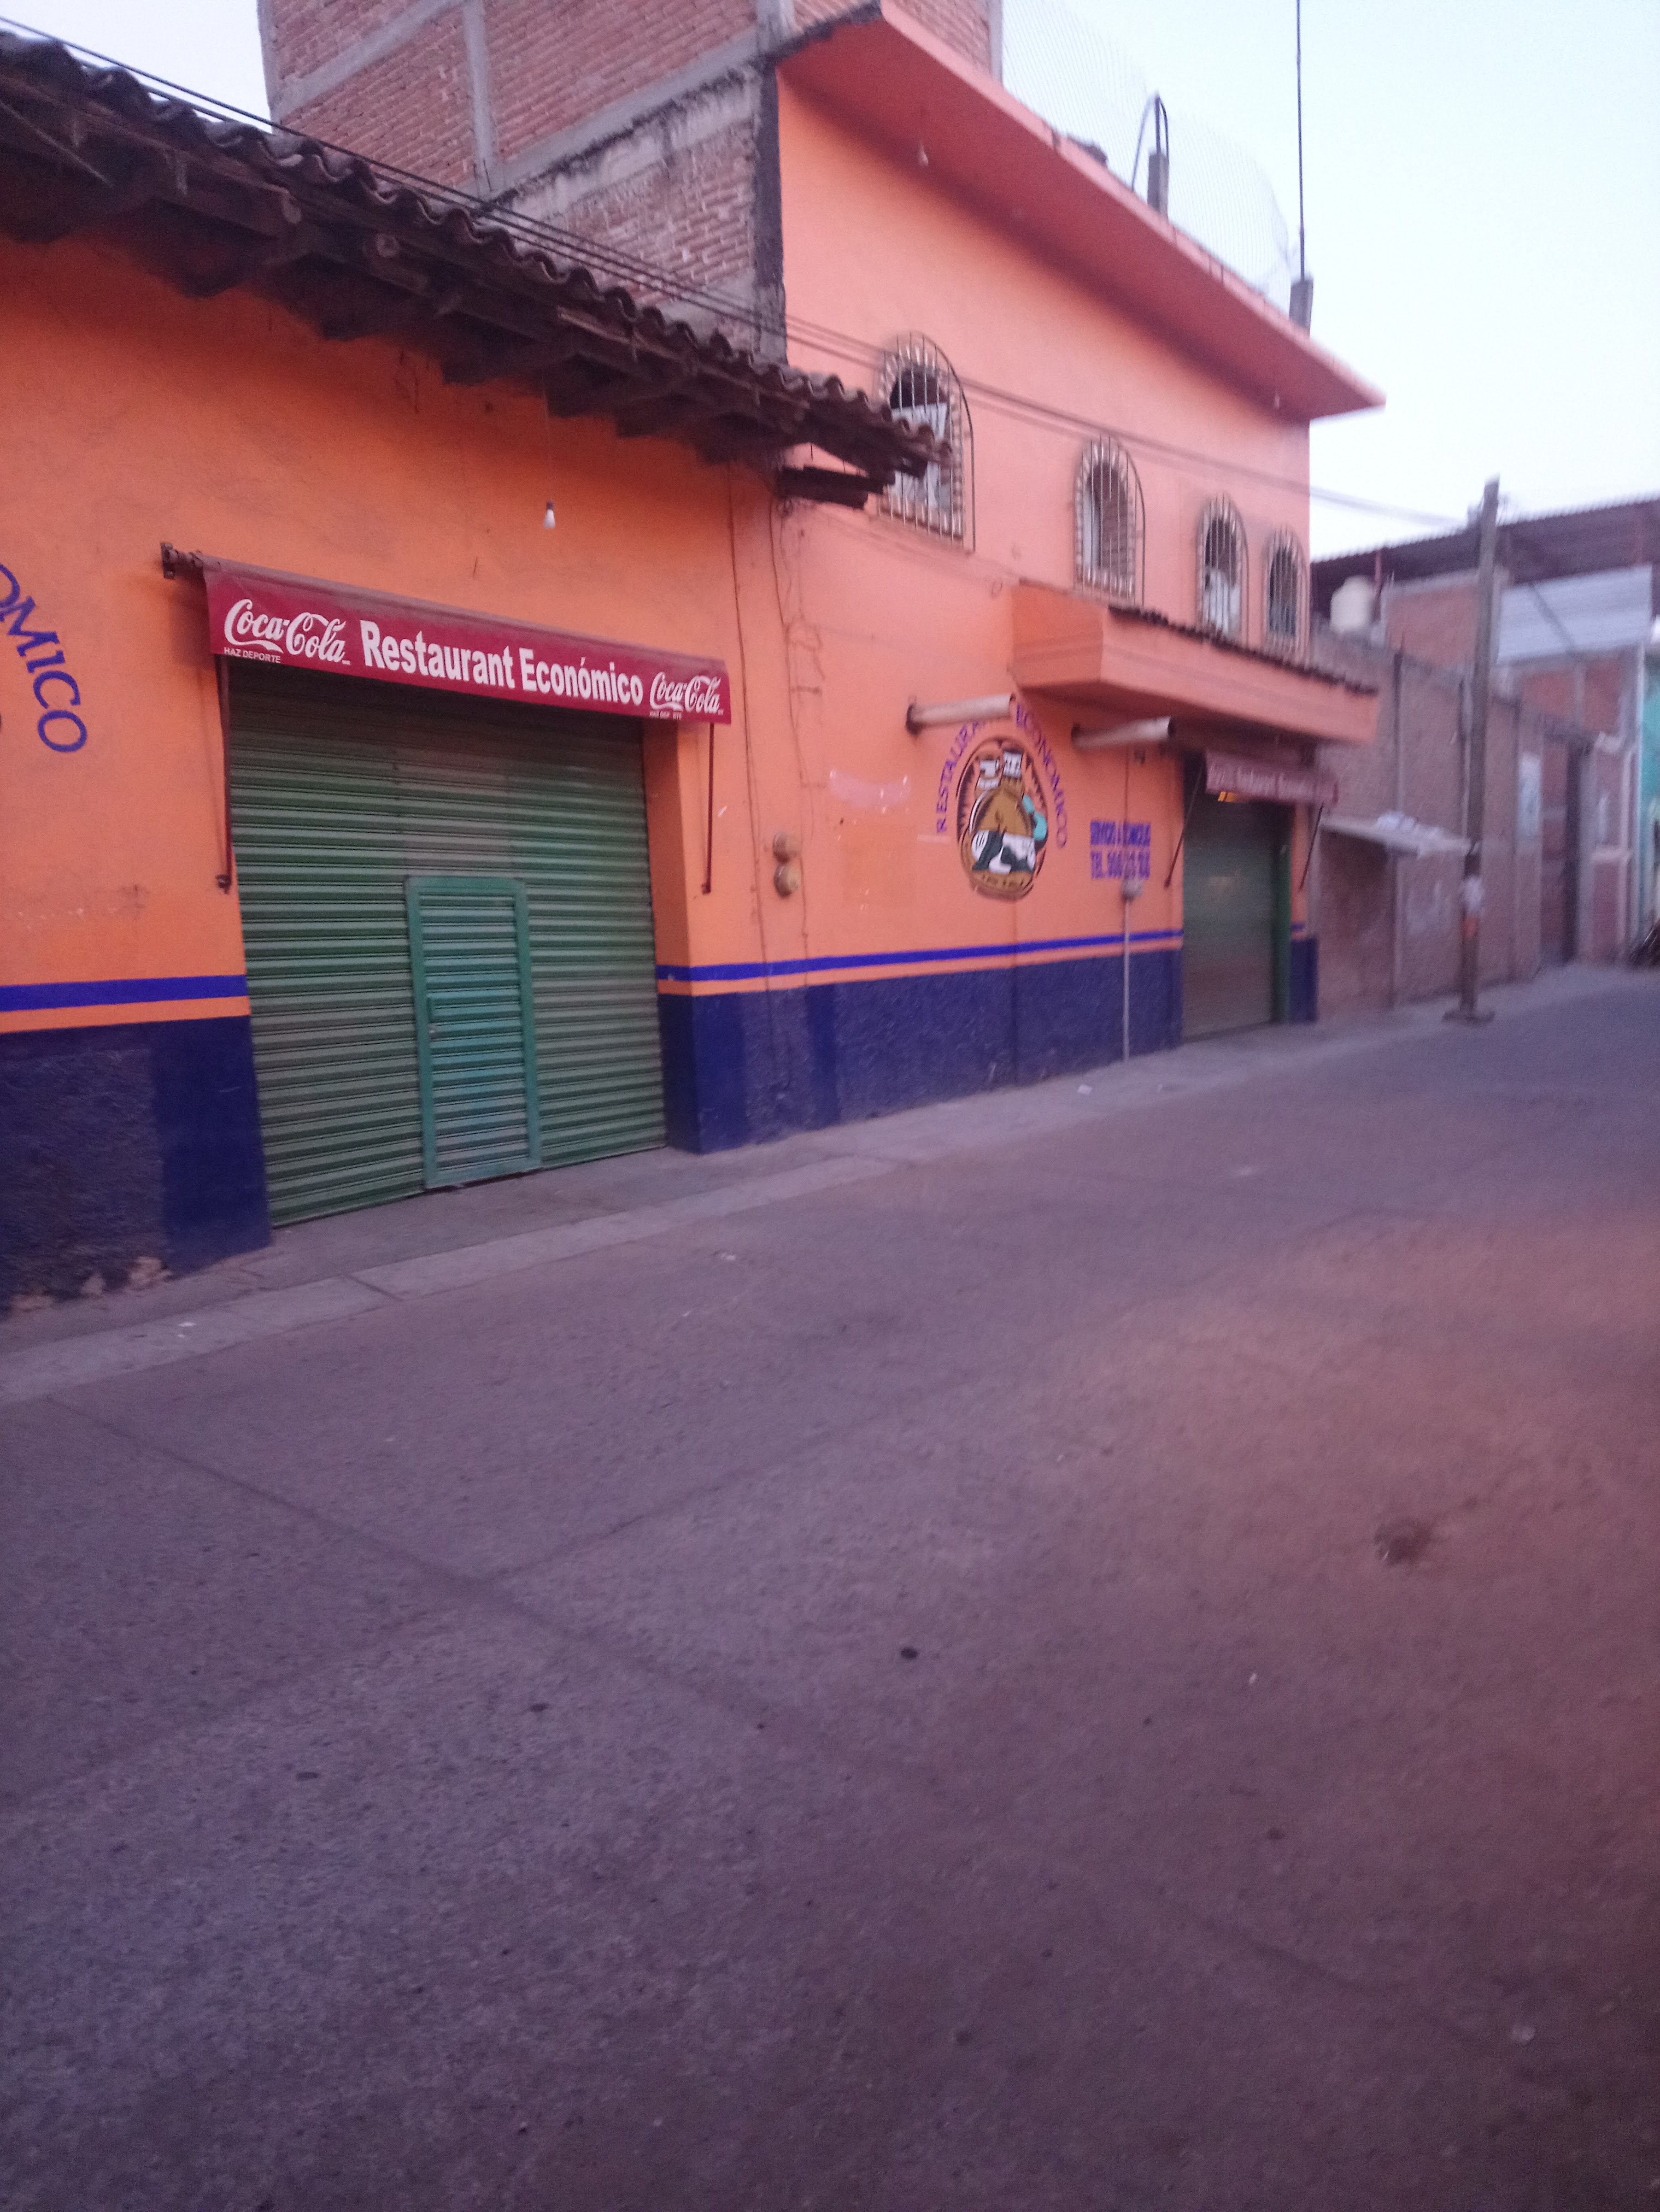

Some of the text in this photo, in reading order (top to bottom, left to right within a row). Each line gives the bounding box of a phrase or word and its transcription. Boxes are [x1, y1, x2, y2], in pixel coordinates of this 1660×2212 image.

[223, 647, 281, 664] HAZ DEPORTE
[224, 599, 721, 714] Coca-Cola Restaurant Económico Coca-Cola
